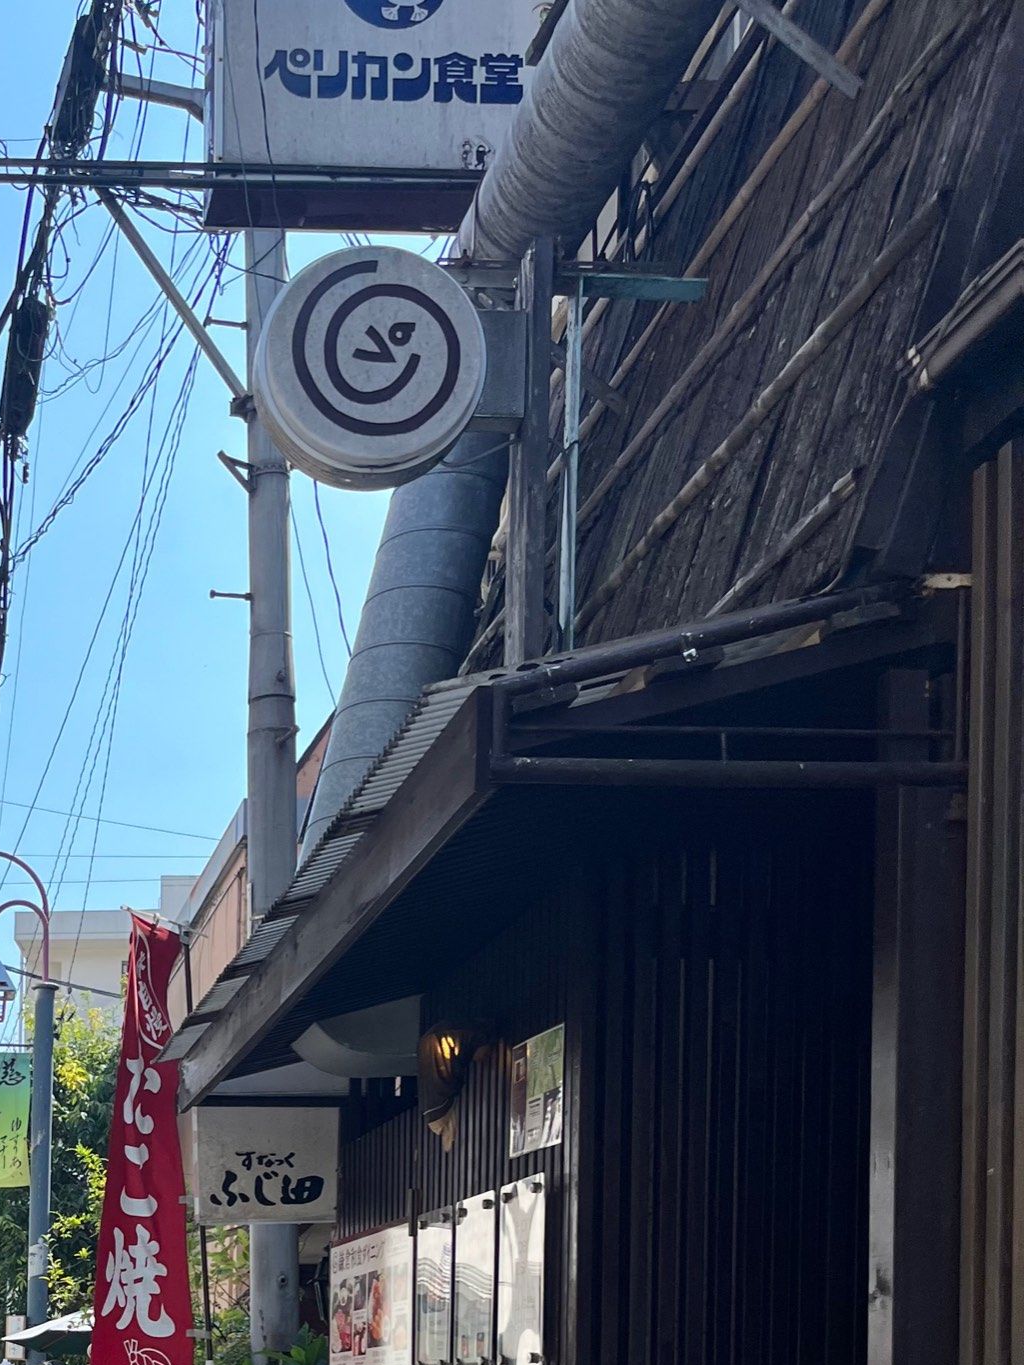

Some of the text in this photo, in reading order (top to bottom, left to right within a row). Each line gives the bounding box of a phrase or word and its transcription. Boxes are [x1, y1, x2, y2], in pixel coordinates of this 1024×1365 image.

[264, 49, 524, 105] ペリカン食堂
[235, 1151, 296, 1171] すなっく
[100, 1057, 175, 1338] たこ焼
